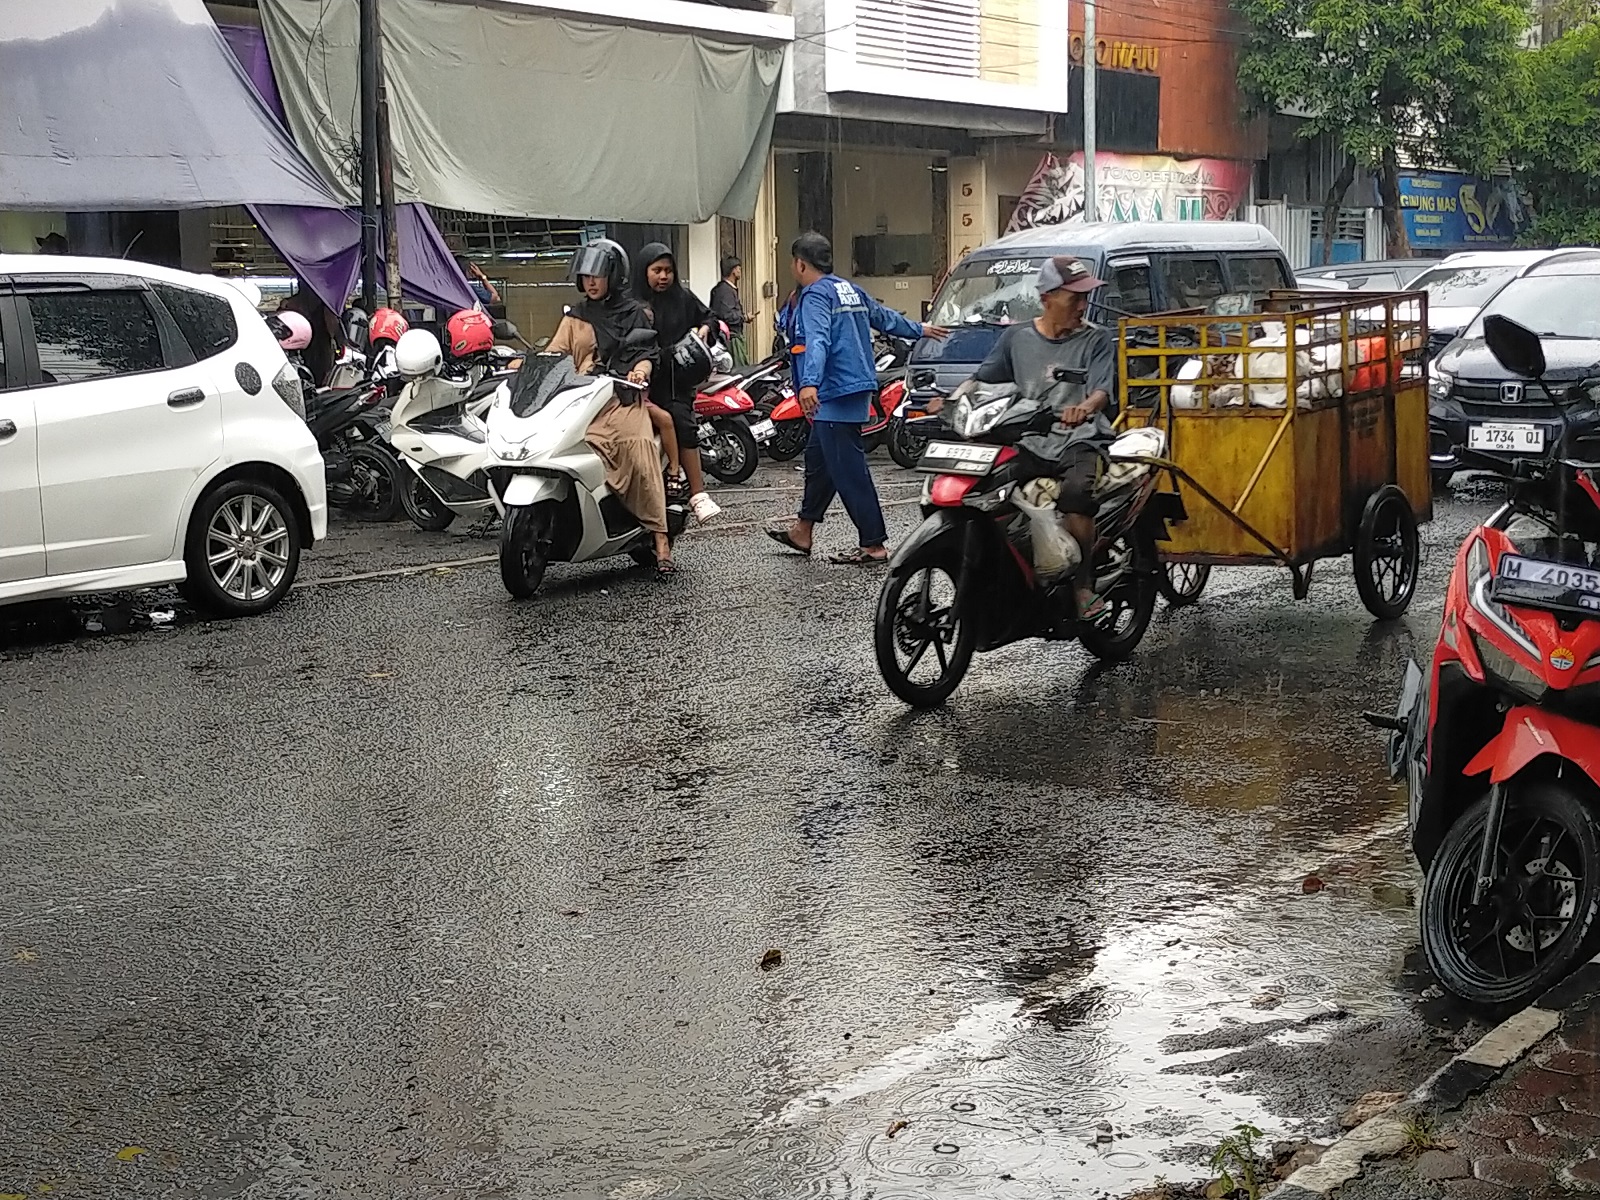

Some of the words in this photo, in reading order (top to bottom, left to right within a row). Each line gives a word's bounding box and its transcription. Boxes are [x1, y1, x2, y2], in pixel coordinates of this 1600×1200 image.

[1102, 166, 1142, 183] TOKO
[962, 183, 973, 197] 5
[962, 213, 973, 227] 5
[1471, 429, 1479, 442] L
[1485, 430, 1515, 443] 1734
[1525, 431, 1541, 444] QI
[1506, 560, 1522, 578] M
